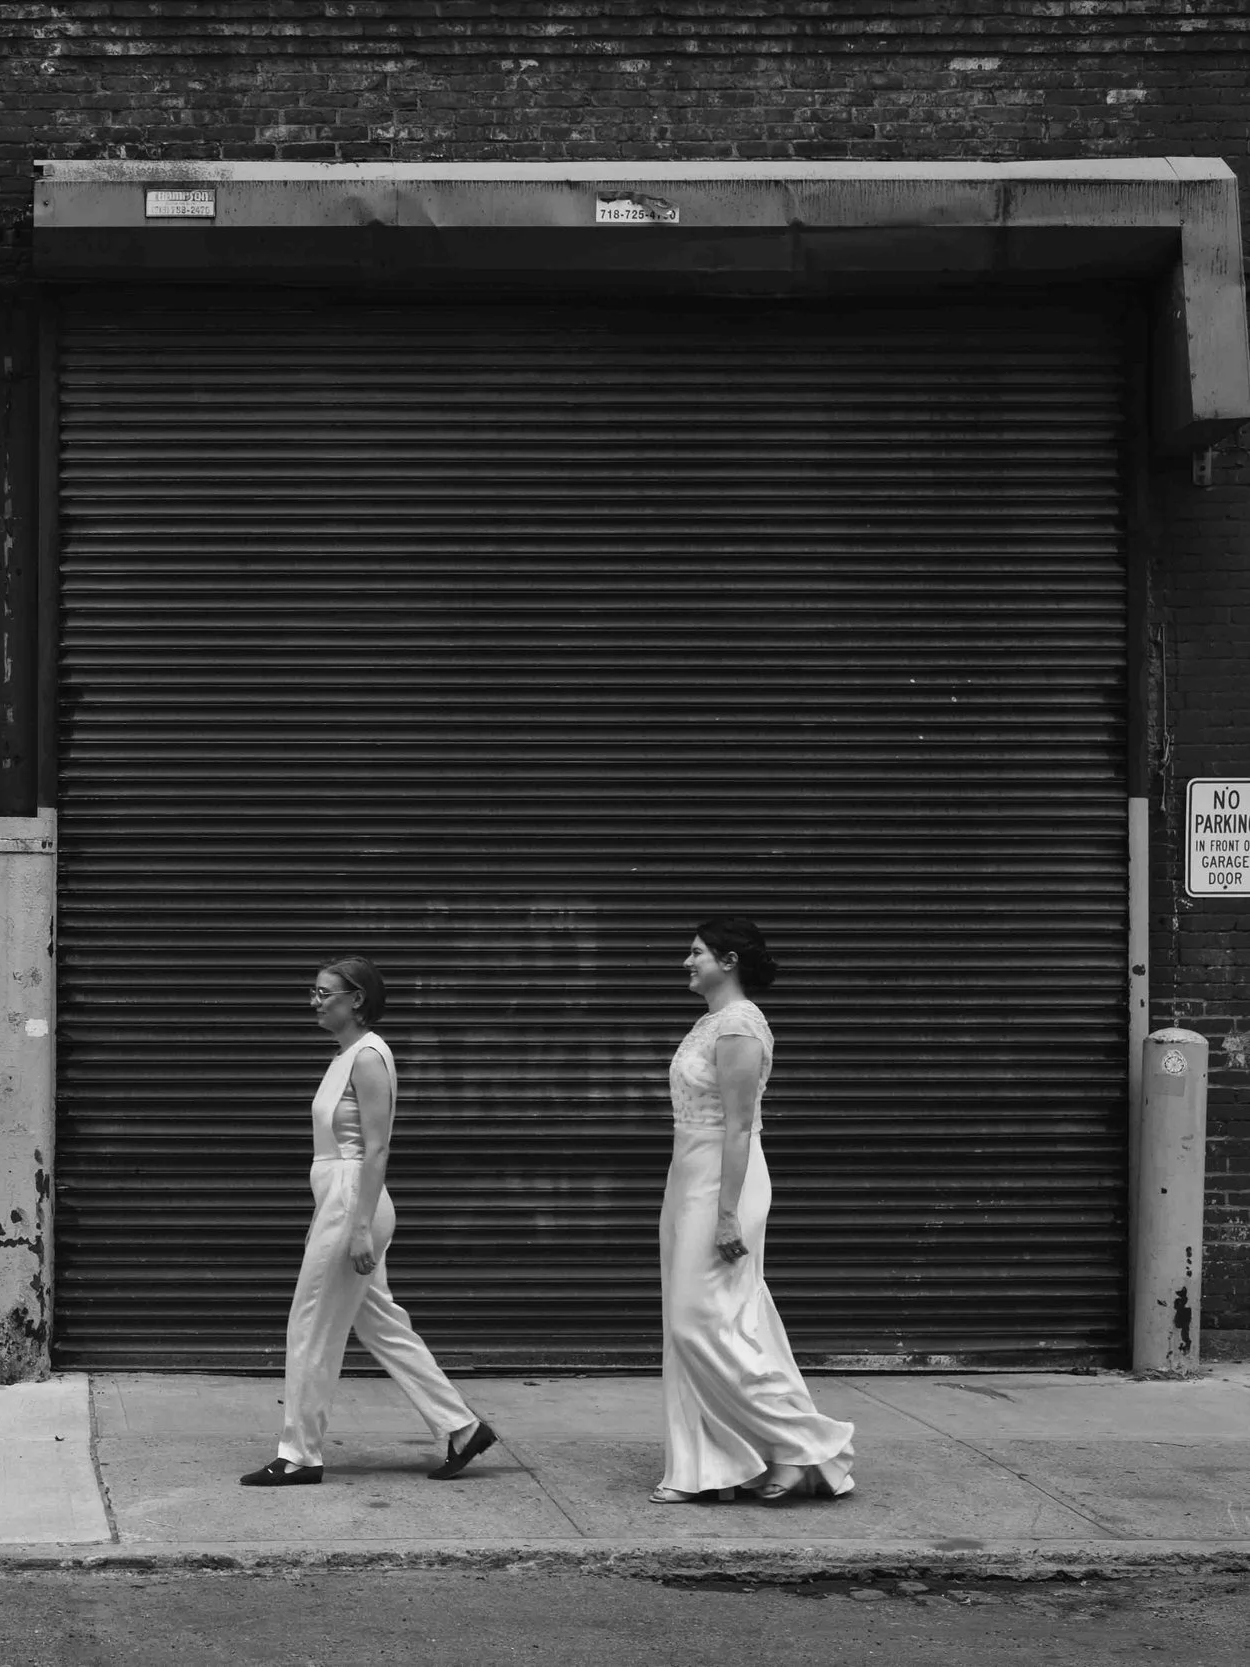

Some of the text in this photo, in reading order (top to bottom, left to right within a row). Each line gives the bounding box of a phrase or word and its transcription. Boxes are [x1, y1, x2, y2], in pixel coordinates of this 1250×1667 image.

[1213, 789, 1240, 809] NO
[1195, 814, 1250, 834] PARKIN
[1195, 840, 1205, 852] IN
[1210, 840, 1239, 852] FRONT
[1201, 856, 1250, 868] GARAGE
[1208, 872, 1242, 885] DOOR
